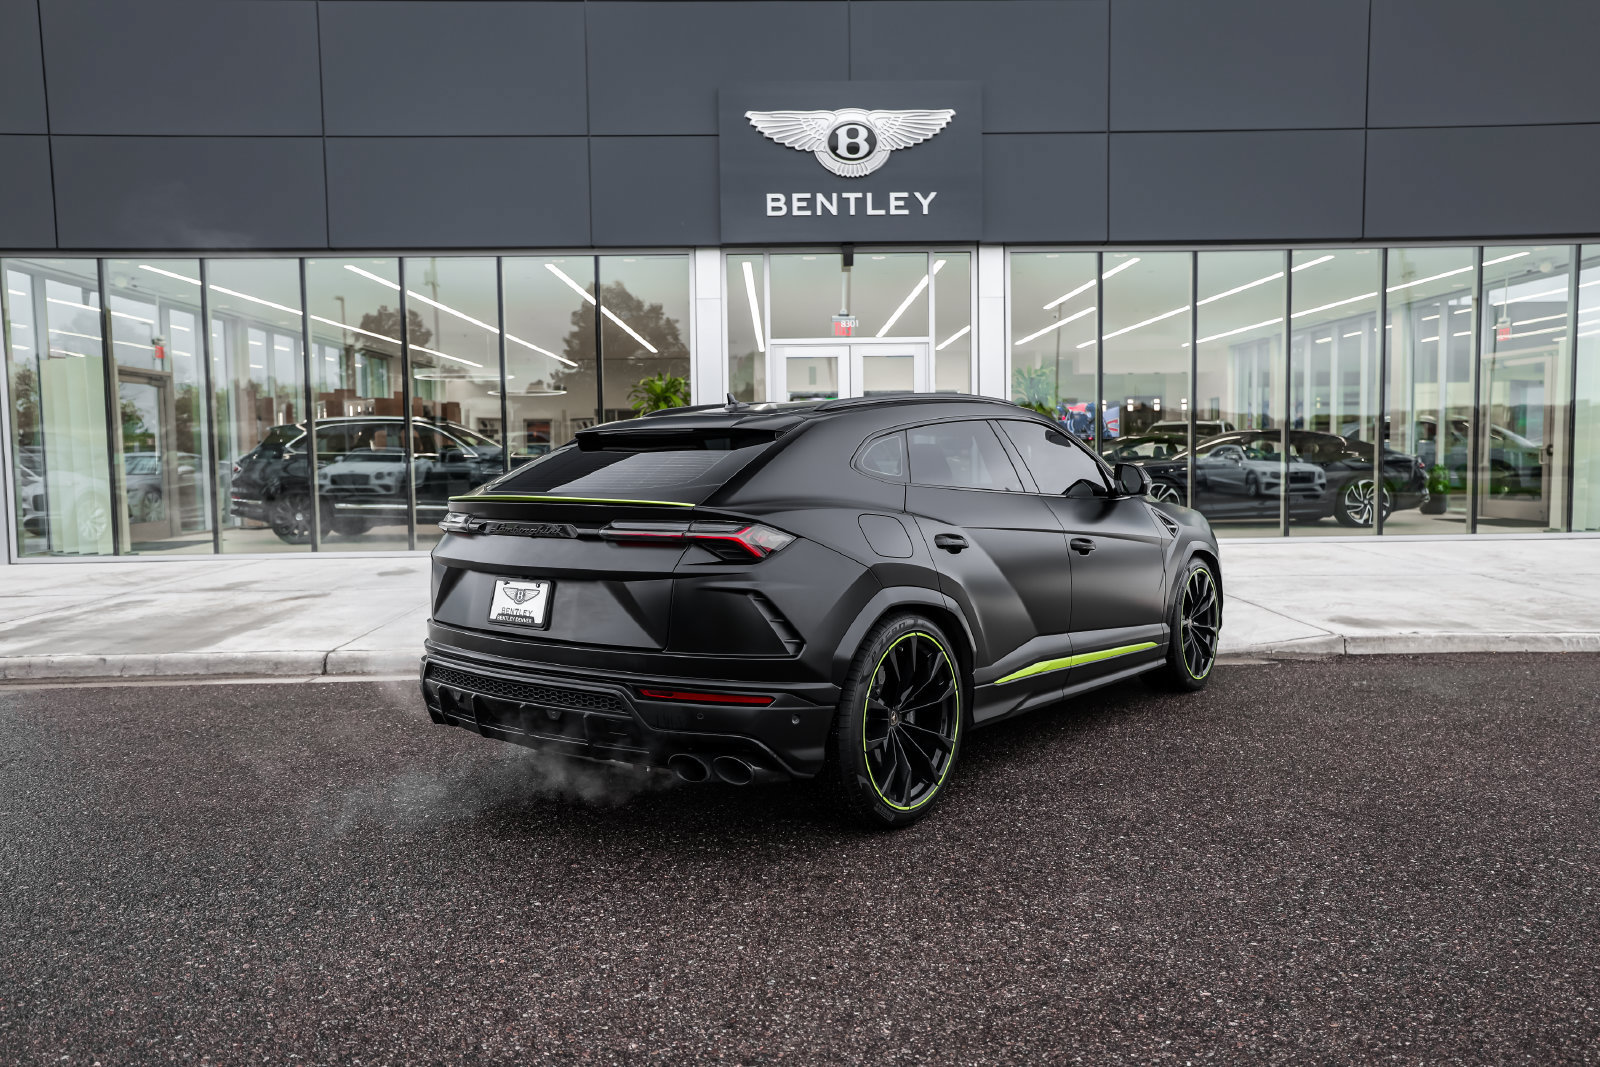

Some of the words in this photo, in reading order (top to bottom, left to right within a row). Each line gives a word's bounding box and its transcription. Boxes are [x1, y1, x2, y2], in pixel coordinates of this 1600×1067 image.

[766, 191, 937, 217] BENTLEY
[841, 319, 859, 328] 8301
[502, 606, 533, 616] BENTLEY
